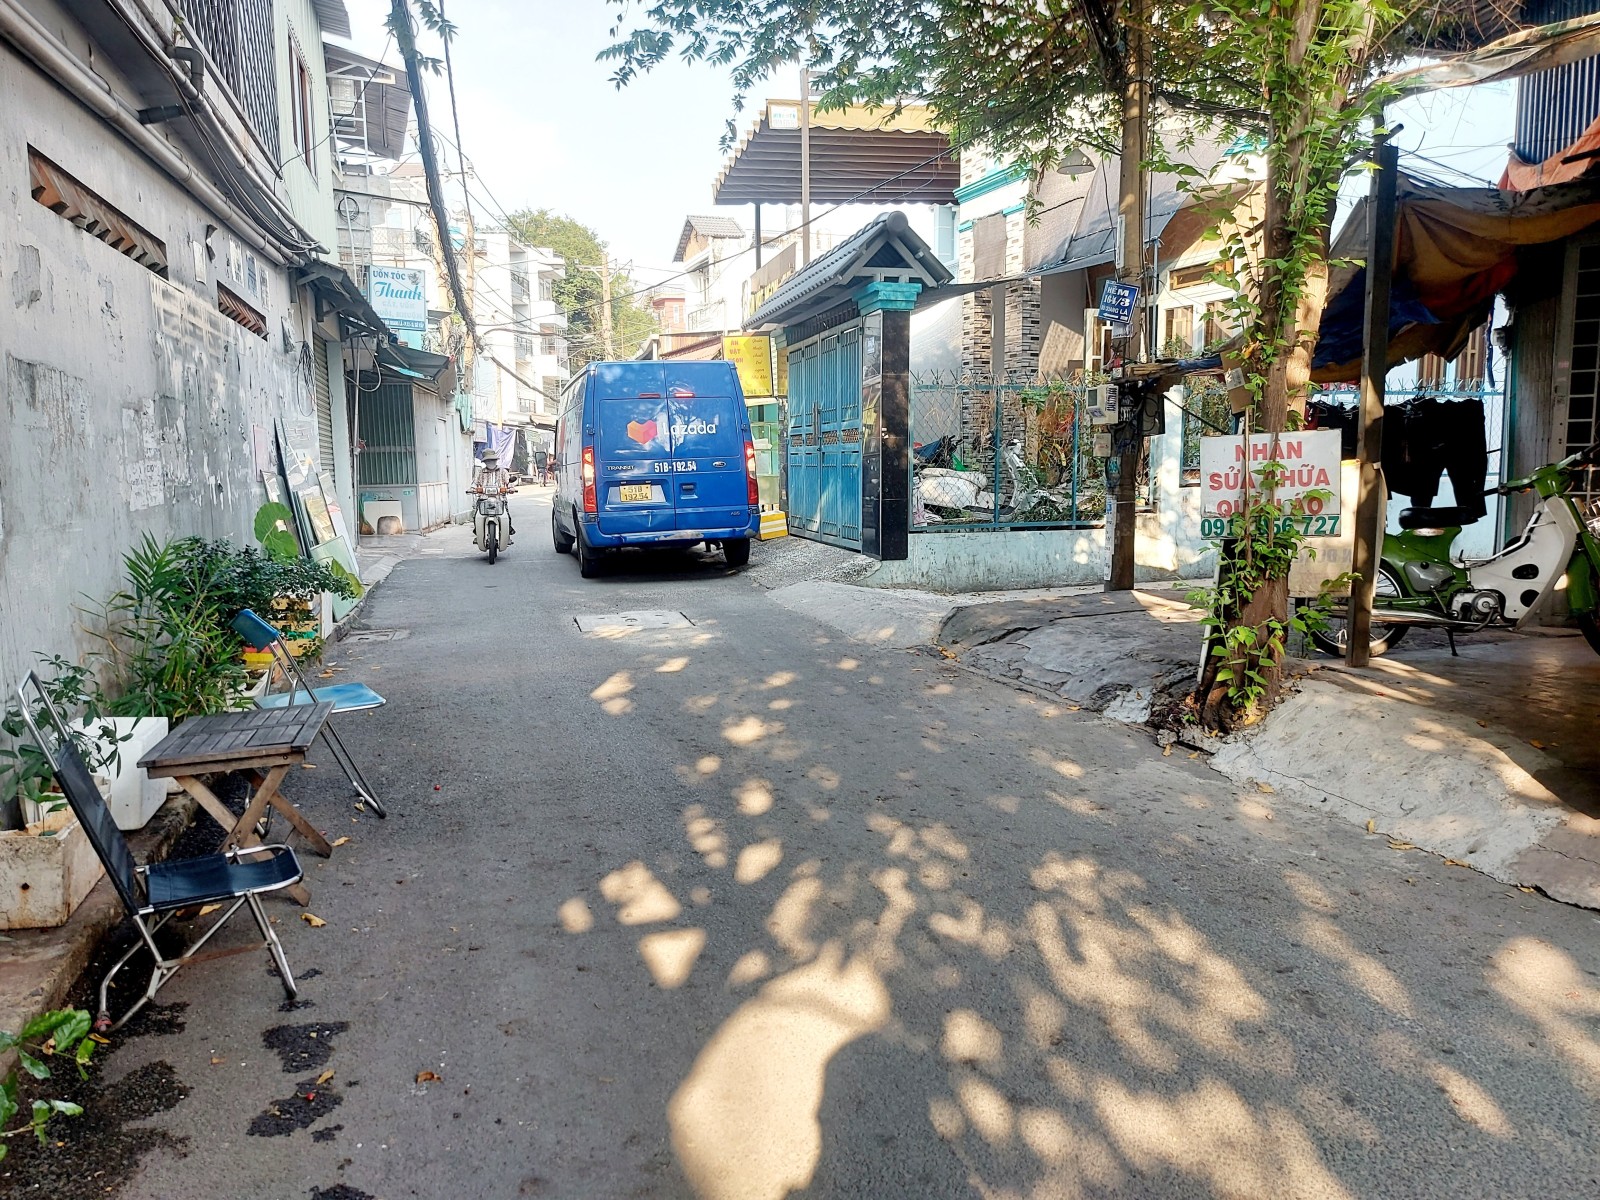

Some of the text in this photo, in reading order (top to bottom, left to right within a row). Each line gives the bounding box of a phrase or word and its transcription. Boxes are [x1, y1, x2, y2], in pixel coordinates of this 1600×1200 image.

[373, 281, 422, 300] Thanh
[663, 421, 716, 435] Lazada
[654, 461, 697, 473] 51B-192.54
